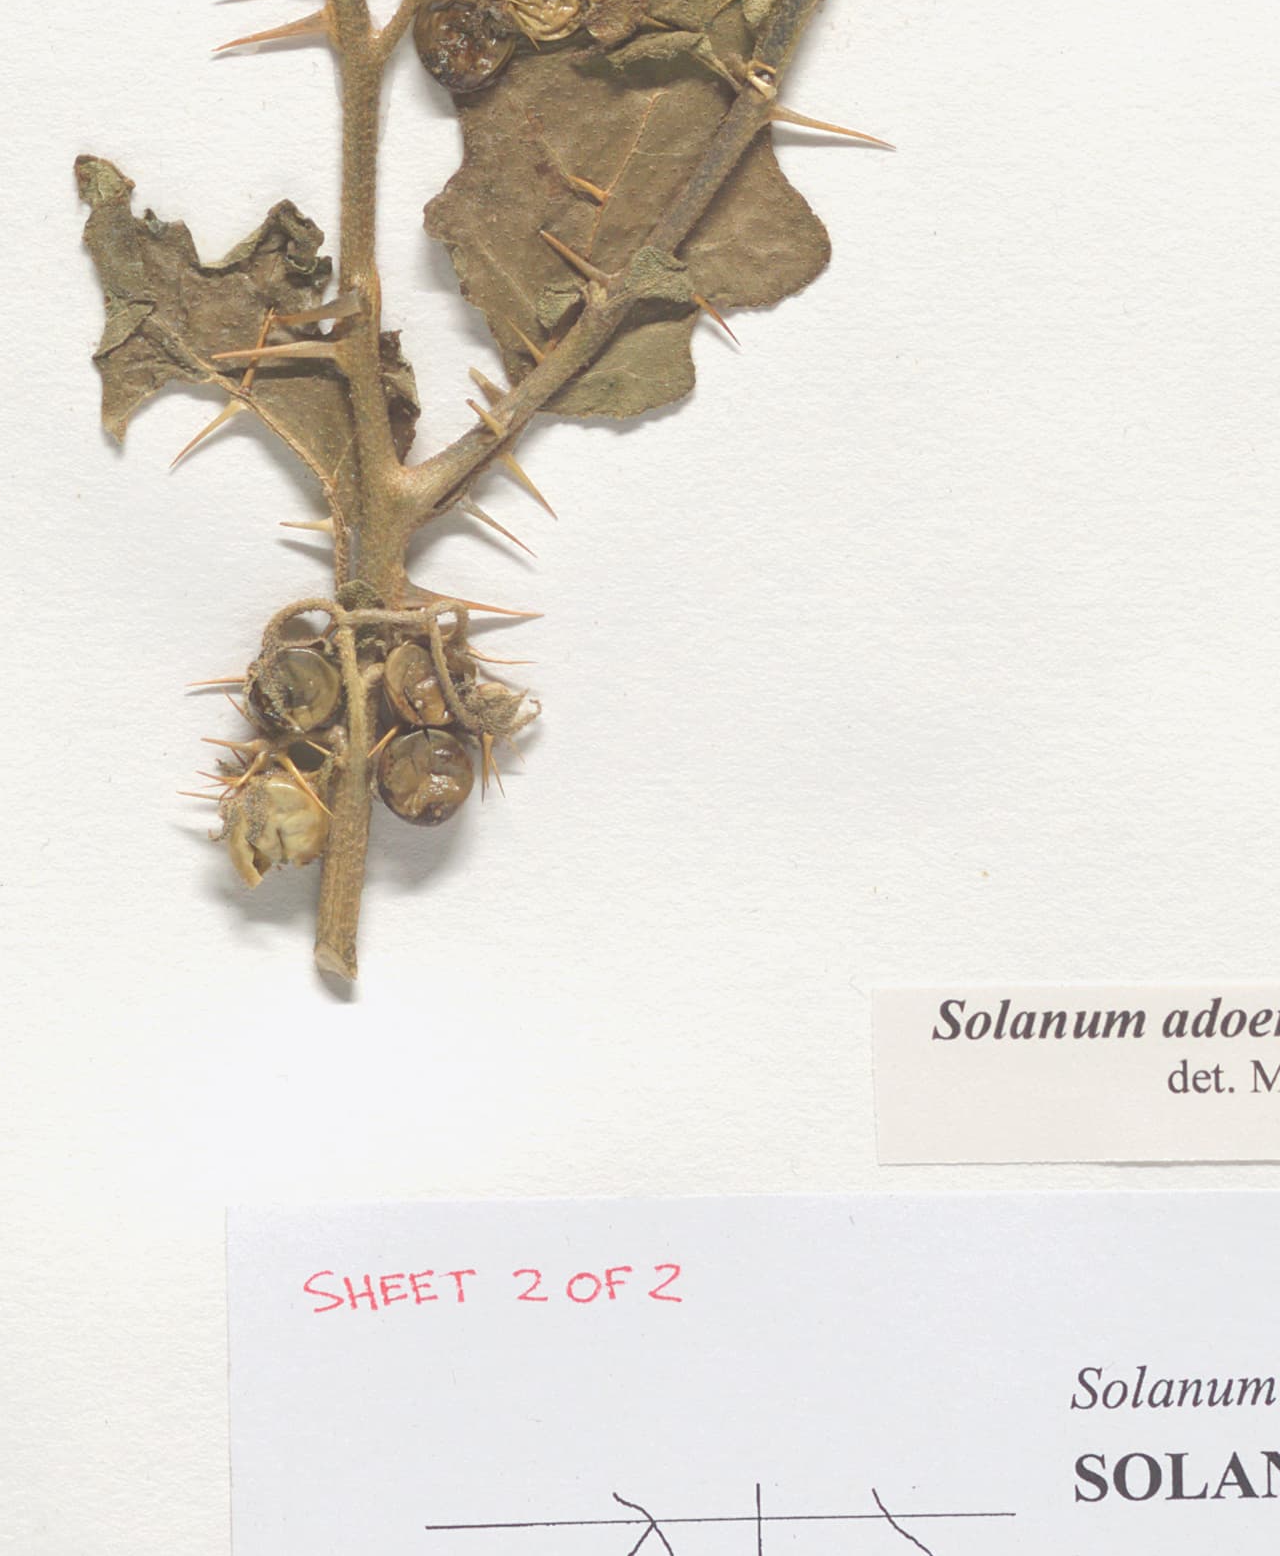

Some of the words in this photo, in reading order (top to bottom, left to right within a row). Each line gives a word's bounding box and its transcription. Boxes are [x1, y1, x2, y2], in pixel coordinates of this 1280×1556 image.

[931, 998, 1147, 1041] Solanum
[1167, 1058, 1235, 1095] det.
[302, 1268, 477, 1314] SHEET
[511, 1268, 549, 1303] 2
[565, 1265, 633, 1305] OF
[647, 1262, 683, 1303] 2
[1069, 1364, 1277, 1410] Solanum
